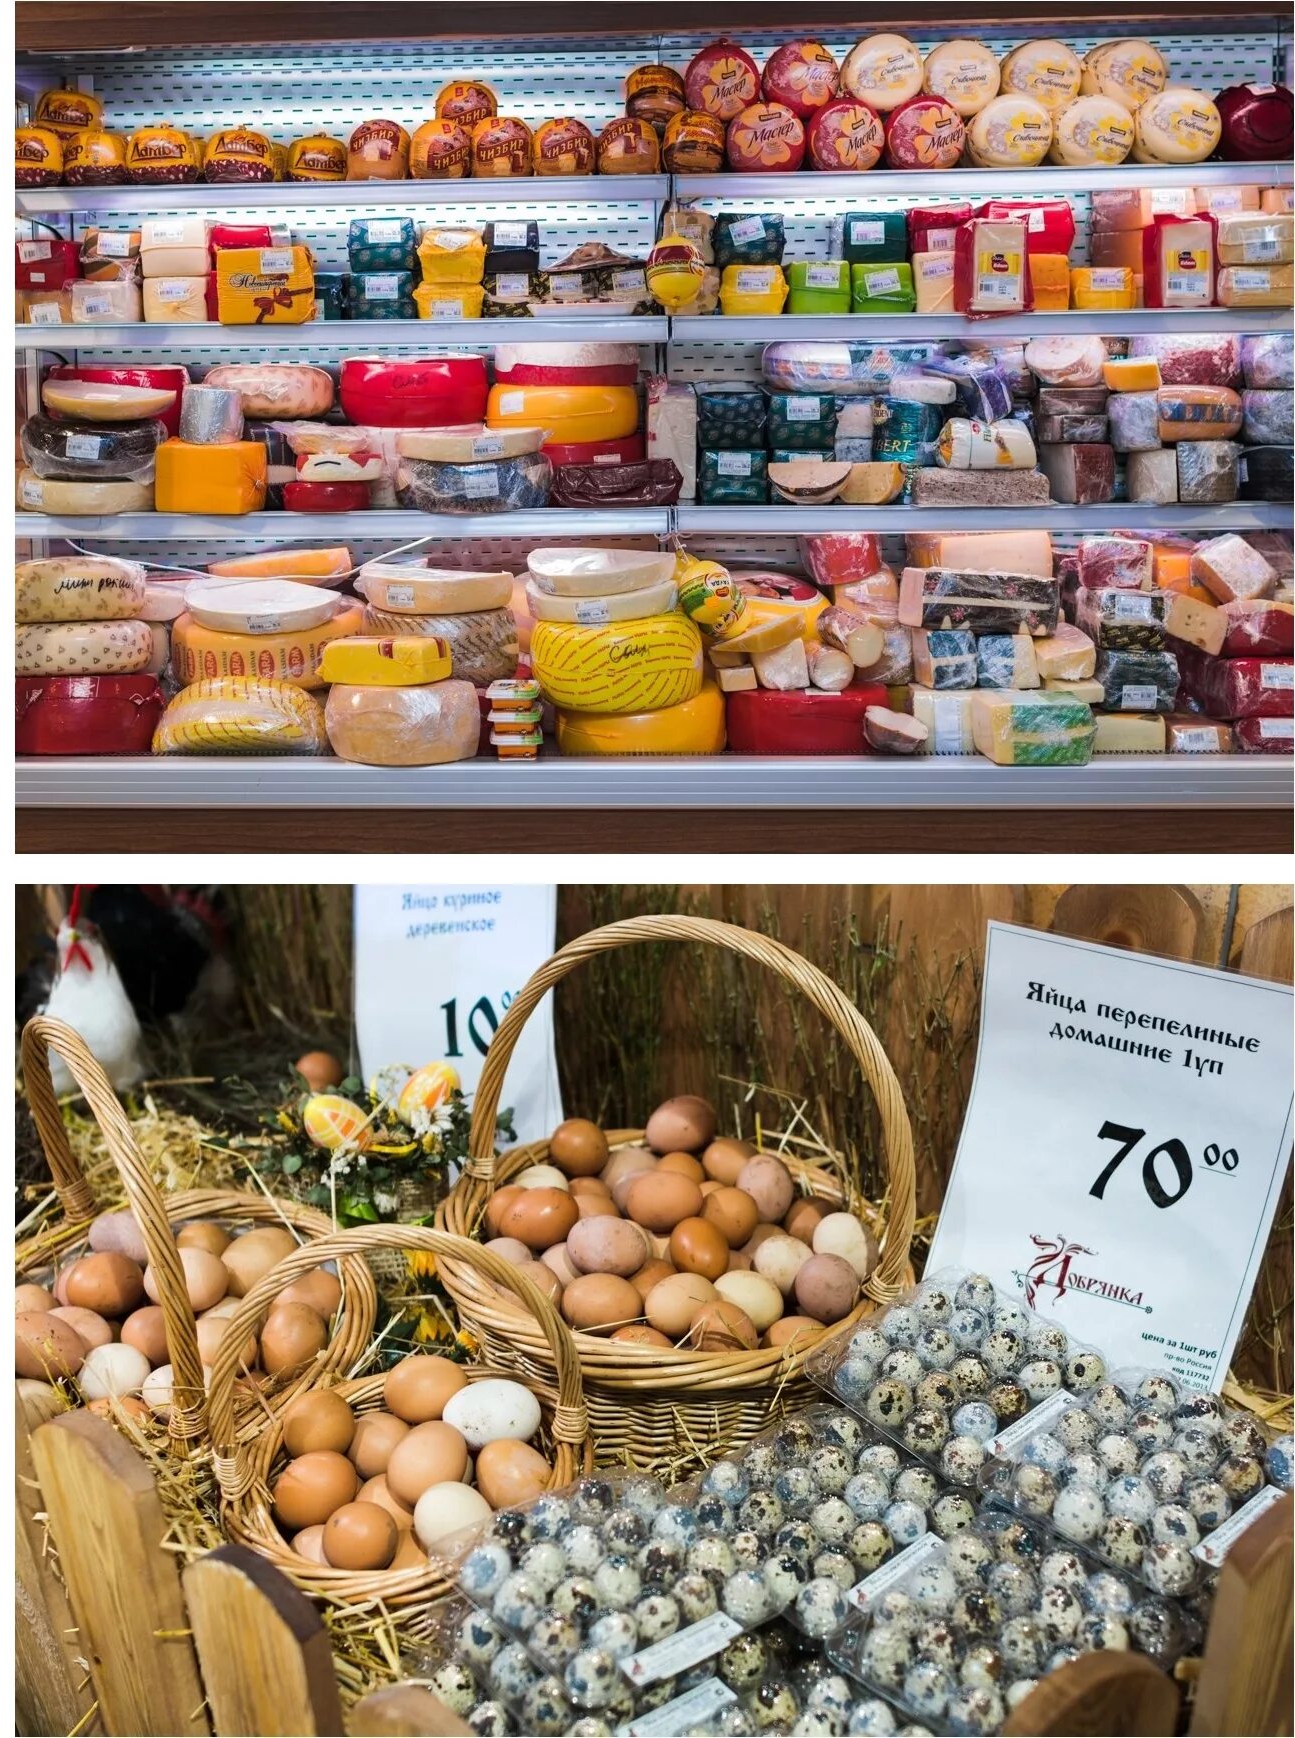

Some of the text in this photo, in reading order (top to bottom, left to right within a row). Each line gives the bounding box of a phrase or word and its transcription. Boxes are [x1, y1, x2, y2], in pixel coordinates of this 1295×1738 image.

[711, 78, 746, 104] Мастер
[453, 109, 487, 124] ИЗБИР
[353, 130, 394, 150] ЧИЗБИР
[545, 137, 588, 158] ЧИЗБИР
[747, 121, 795, 149] Мастер
[846, 124, 877, 156] Мастер
[924, 126, 963, 154] Мастер
[480, 140, 525, 160] ЧИЗБИР
[1025, 980, 1087, 1014] Яйца
[1048, 1022, 1173, 1063] домашние
[1088, 1119, 1240, 1209] 70 00
[1141, 1331, 1217, 1359] цена за 1шт руб
[1163, 1352, 1212, 1370] пр-во Россия
